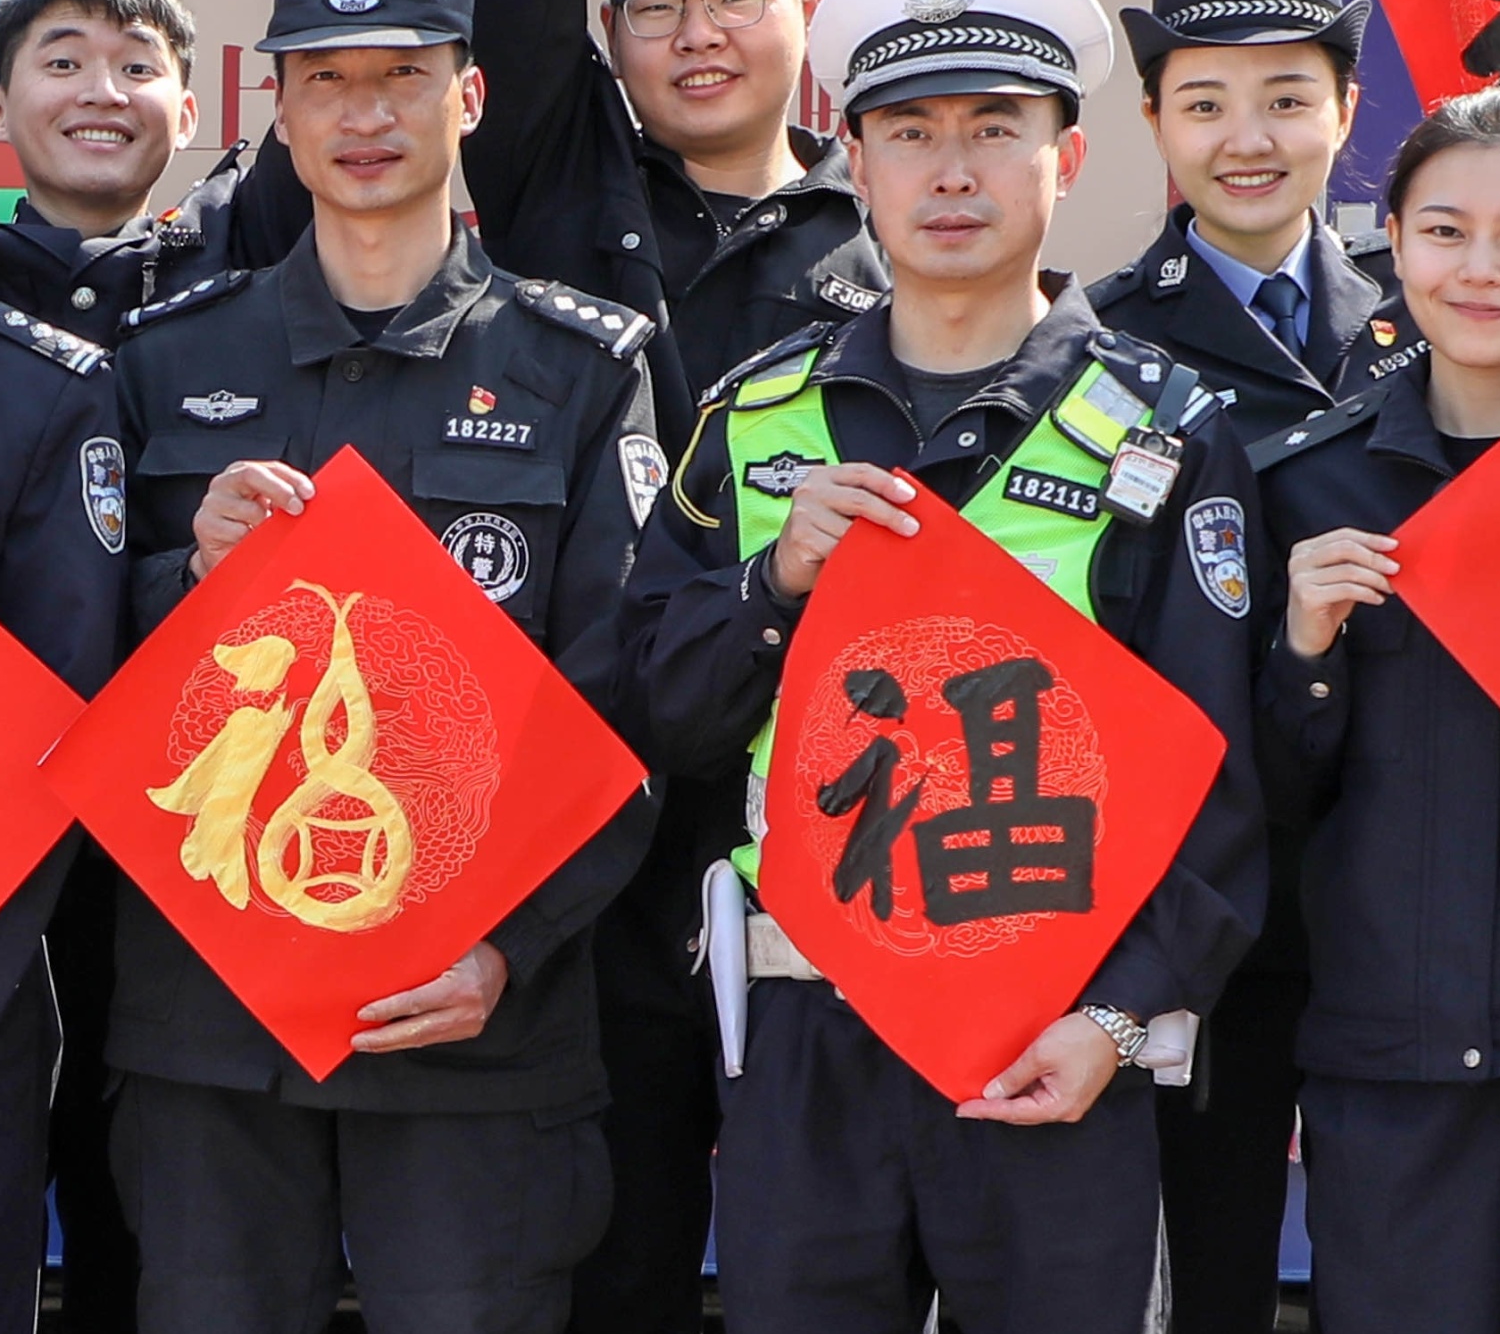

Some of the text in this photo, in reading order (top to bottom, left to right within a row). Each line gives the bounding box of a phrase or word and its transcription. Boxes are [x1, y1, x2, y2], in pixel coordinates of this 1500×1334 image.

[446, 417, 532, 445] 182227
[1008, 473, 1098, 515] 182113
[470, 530, 497, 581] 特警
[144, 578, 415, 934] 福
[816, 656, 1096, 927] 福
